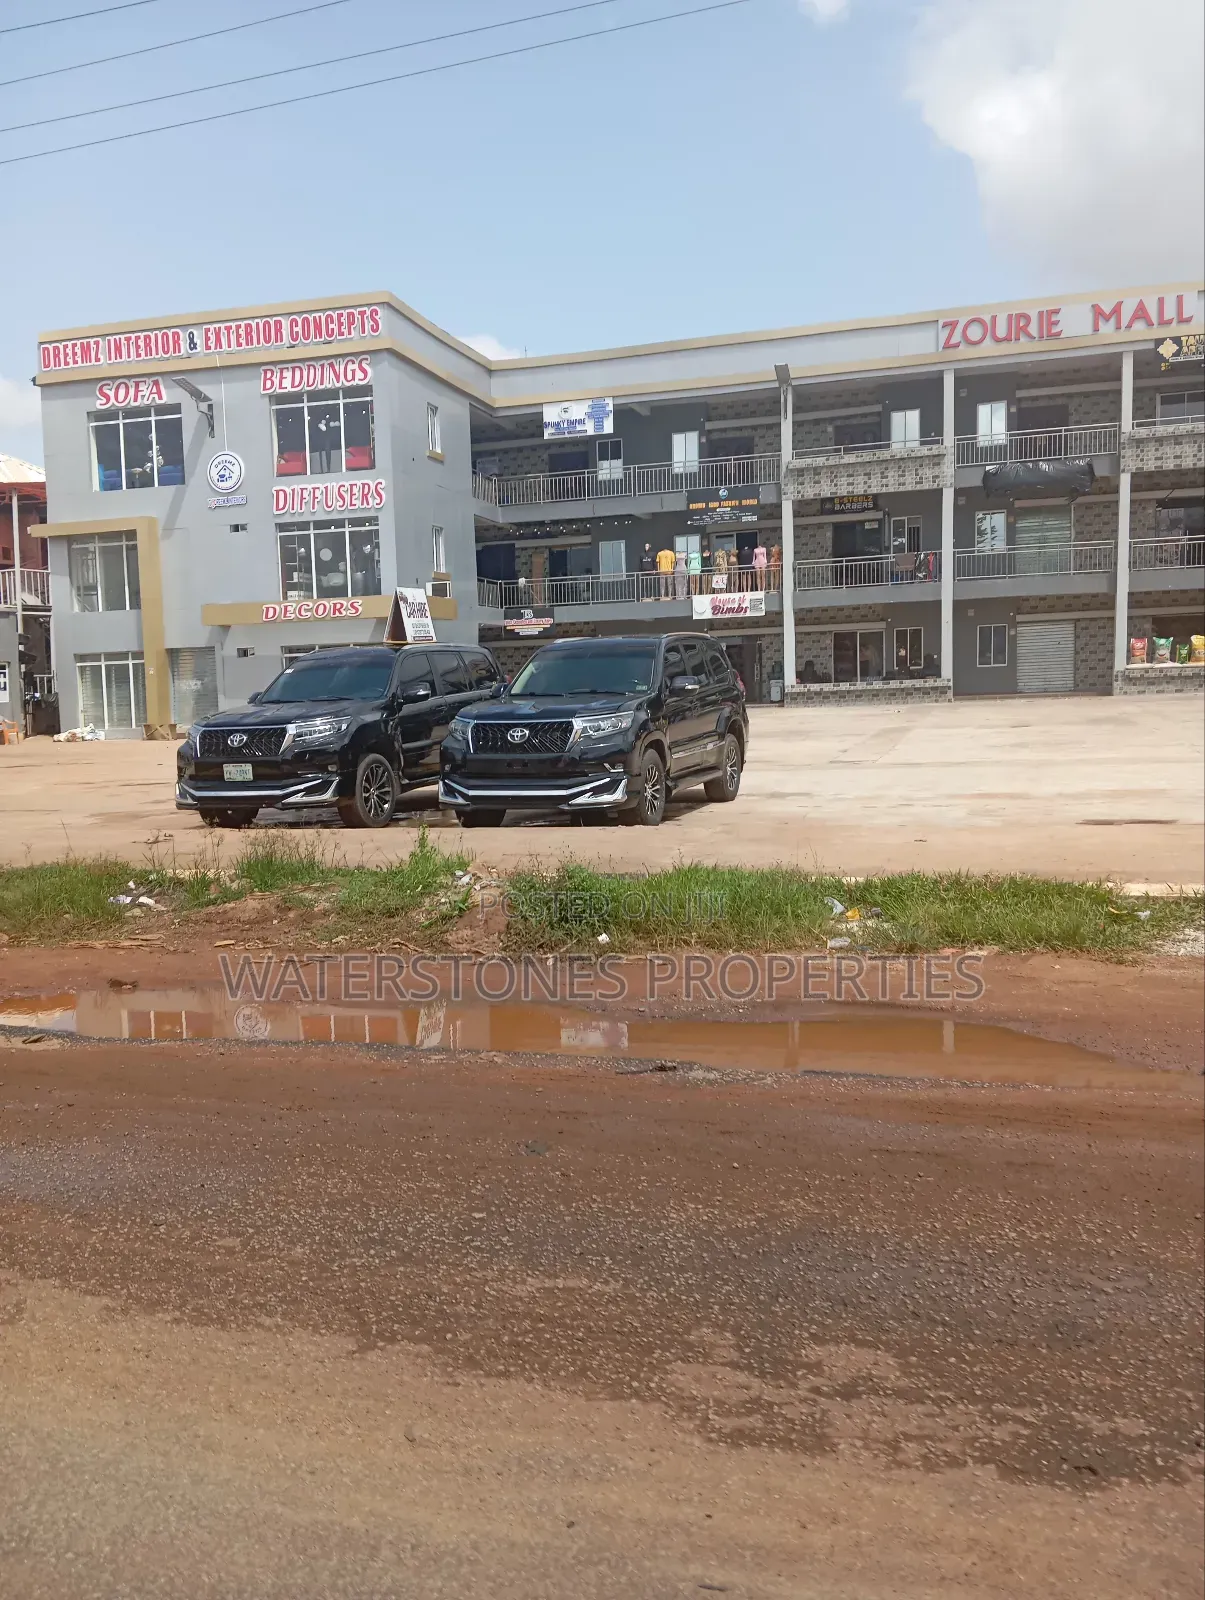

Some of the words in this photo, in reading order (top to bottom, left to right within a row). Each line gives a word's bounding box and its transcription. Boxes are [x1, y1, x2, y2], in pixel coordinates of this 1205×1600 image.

[942, 307, 1063, 349] ZOURIE
[1092, 294, 1194, 333] MALL
[40, 339, 103, 370] DREEMZ
[106, 331, 182, 363] INTERIOR
[187, 330, 198, 352] &
[203, 317, 285, 352] EXTERIOR
[289, 307, 382, 343] CONCEPTS
[260, 356, 372, 395] BEDDINGS
[96, 378, 167, 409] SOFA
[273, 479, 386, 514] DIFFUSERS
[834, 501, 874, 511] BARBERS
[262, 598, 363, 622] DECORS
[711, 603, 749, 616] Bimbs
